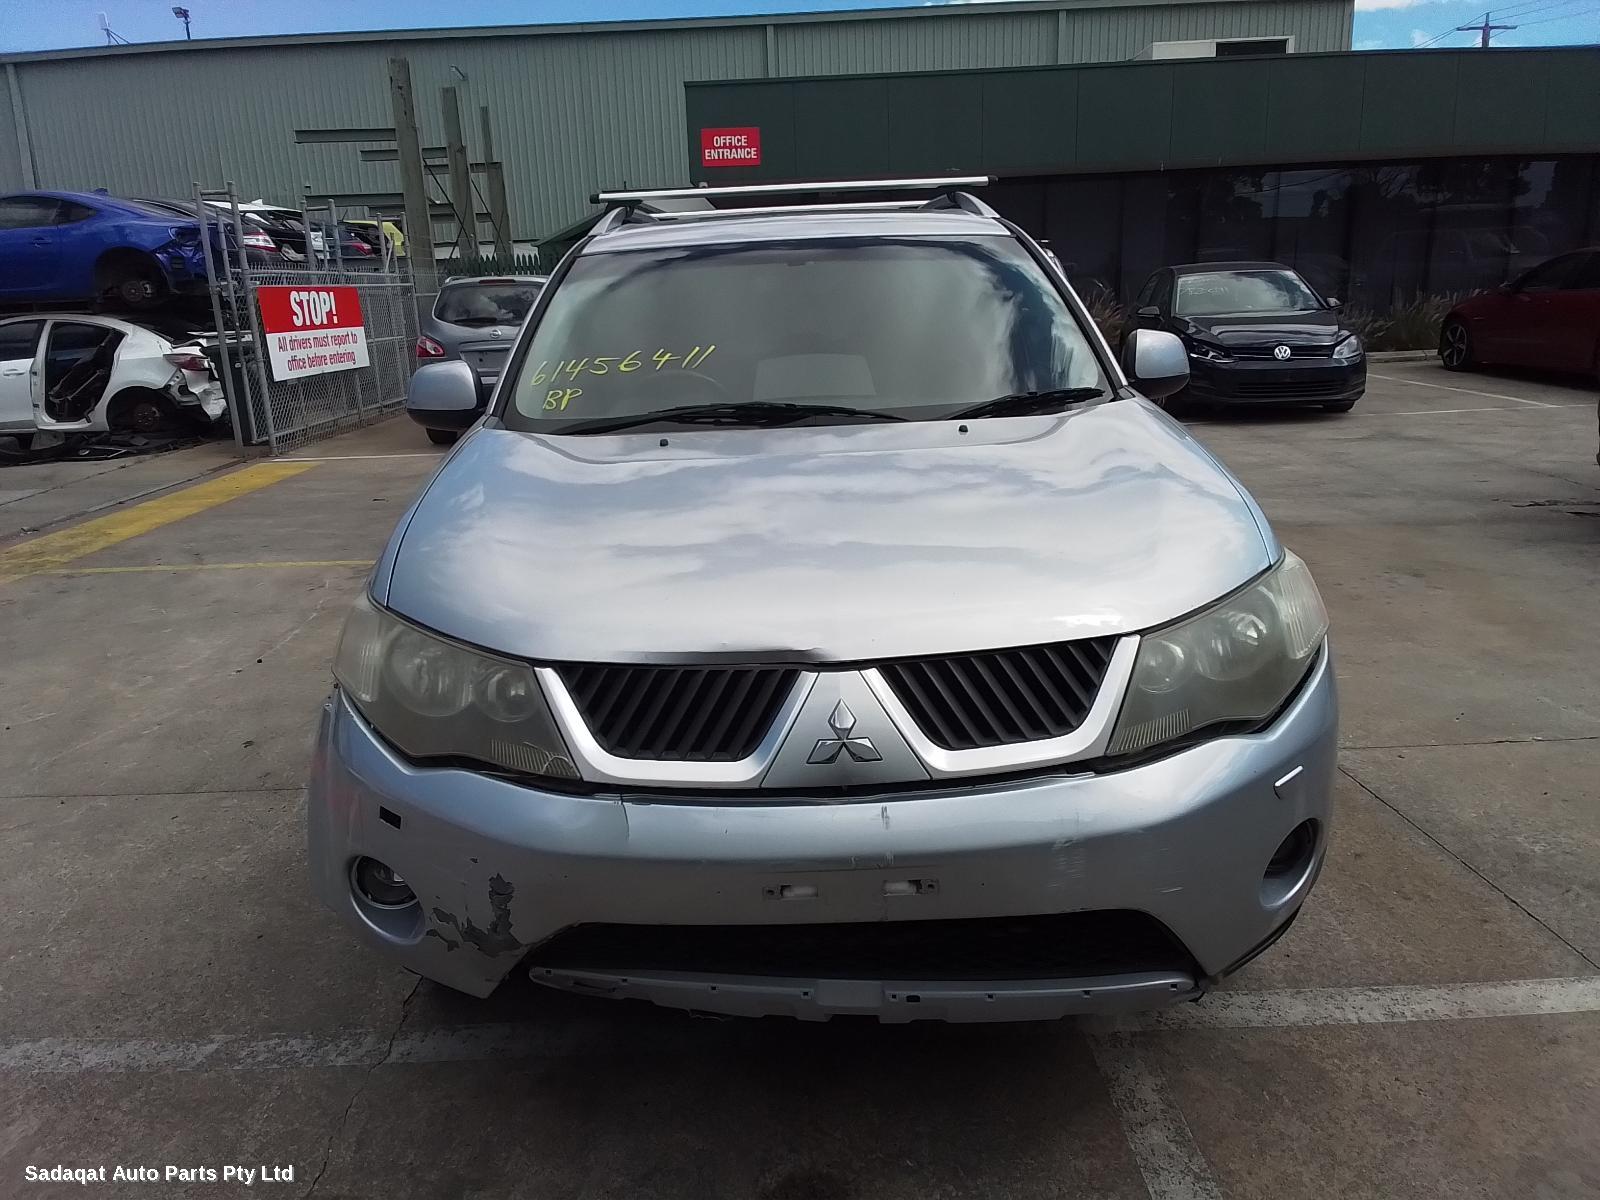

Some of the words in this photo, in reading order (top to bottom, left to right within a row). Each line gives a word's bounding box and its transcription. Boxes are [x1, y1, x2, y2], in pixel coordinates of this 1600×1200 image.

[713, 135, 748, 147] OFFICE
[705, 148, 757, 160] ENTRANCE
[290, 291, 338, 326] STOP!
[278, 336, 288, 352] All
[289, 335, 313, 351] drivers
[313, 333, 330, 347] must
[331, 331, 350, 348] report
[351, 332, 357, 344] to
[287, 355, 306, 371] office
[307, 352, 328, 368] before
[329, 349, 355, 365] entering
[542, 388, 583, 411] BP
